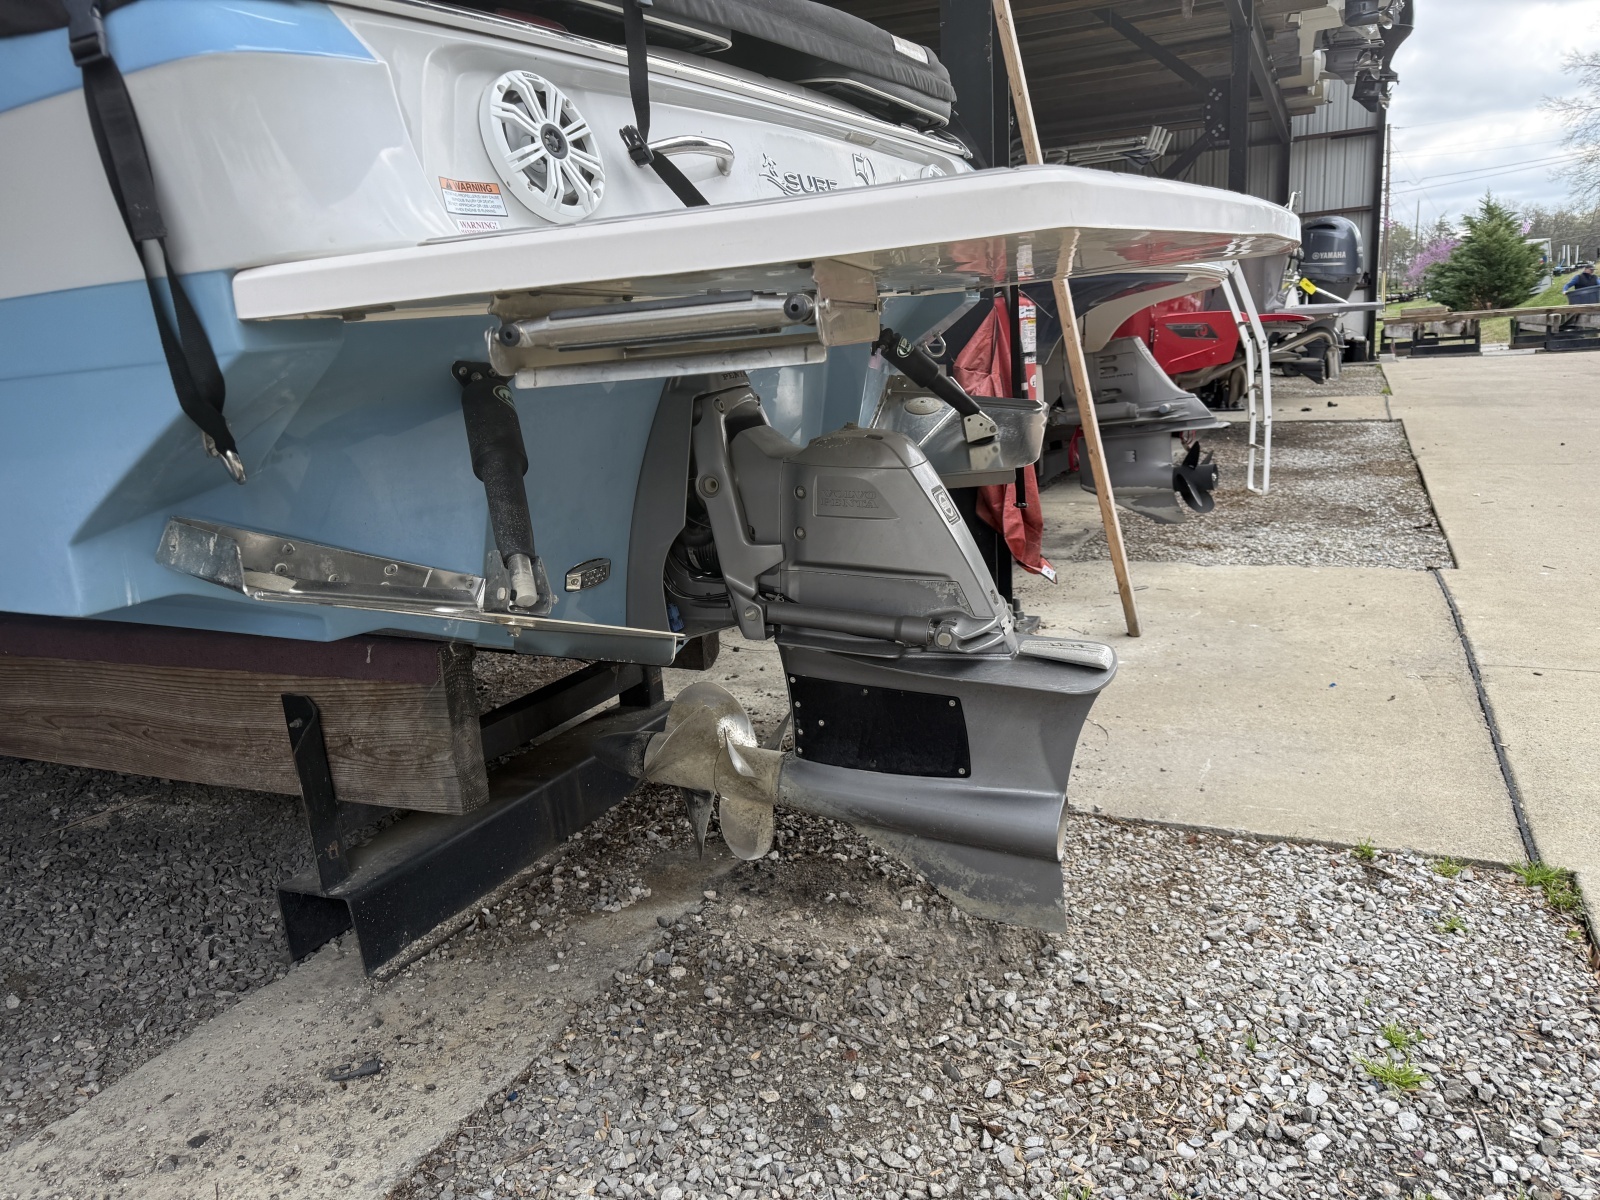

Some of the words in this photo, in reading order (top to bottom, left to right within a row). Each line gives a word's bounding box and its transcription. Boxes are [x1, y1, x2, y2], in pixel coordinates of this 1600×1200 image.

[452, 181, 493, 193] WARNING
[784, 171, 838, 194] SURF
[459, 221, 498, 229] WARNING!
[1320, 251, 1347, 259] YAMAHA
[820, 489, 877, 500] VOLVO
[820, 498, 879, 509] PENTA
